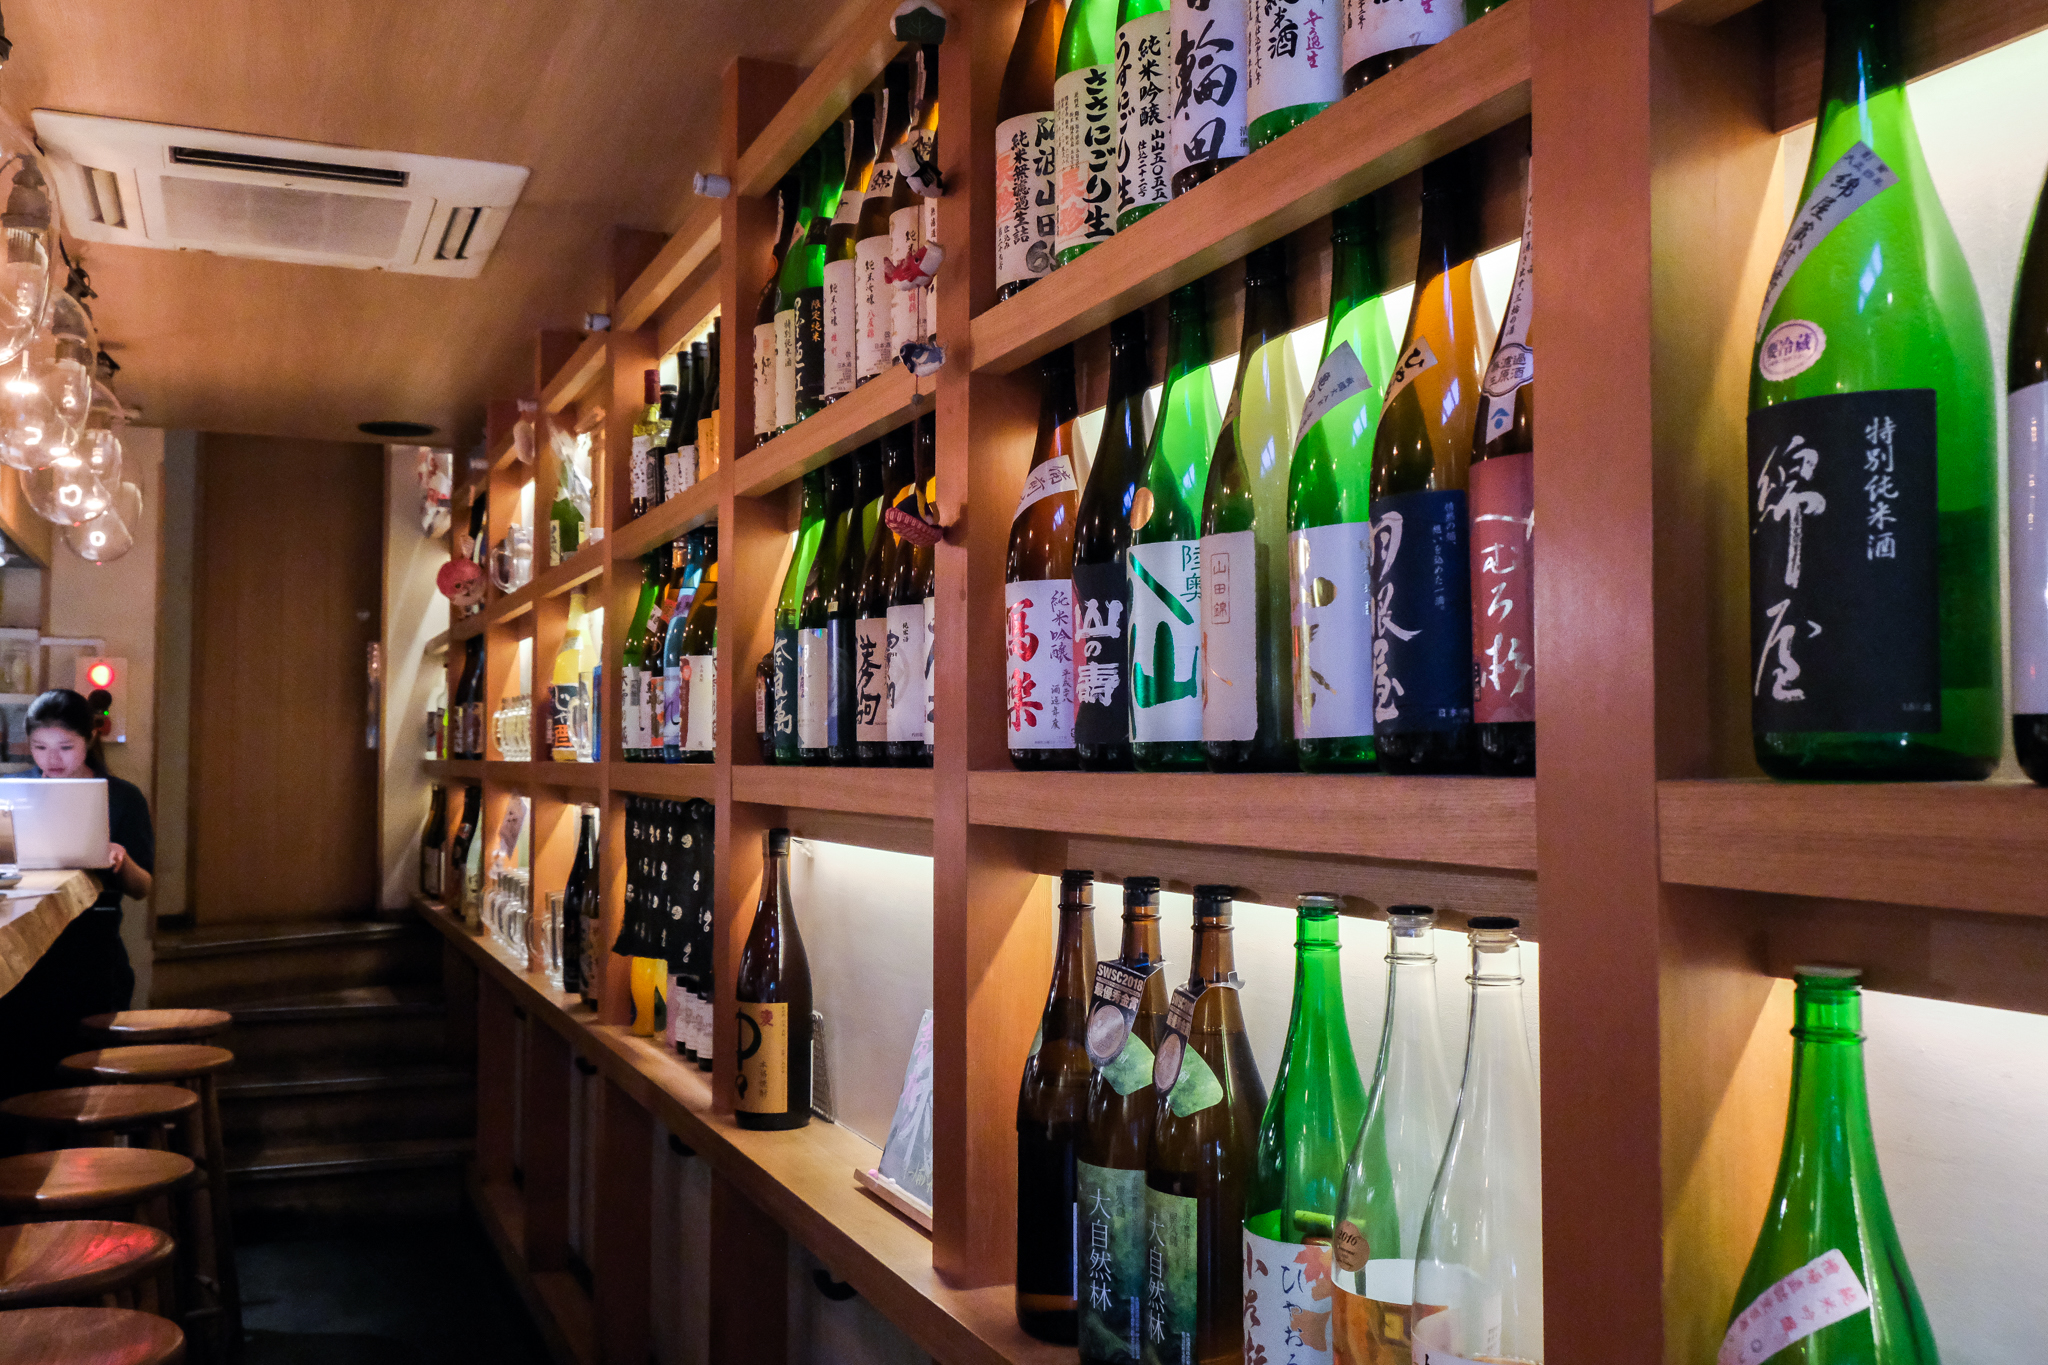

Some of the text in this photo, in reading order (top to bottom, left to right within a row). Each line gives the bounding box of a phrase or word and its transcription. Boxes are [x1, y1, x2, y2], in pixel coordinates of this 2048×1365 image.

[1138, 35, 1165, 127] 純米吟醸
[1083, 68, 1116, 239] ささにごり生
[1116, 32, 1136, 212] うすにごり生
[811, 299, 823, 342] 限定純米
[908, 289, 917, 313] 田錦
[1864, 416, 1899, 560] 特別純米酒
[1212, 559, 1228, 618] 山田錦
[1050, 590, 1073, 663] 純米吟醸
[1051, 684, 1061, 730] 酒造年度
[1097, 964, 1144, 992] SWSC2018
[1089, 1188, 1113, 1312] 大自然林
[1337, 1229, 1358, 1247] 2016
[1149, 1213, 1166, 1344] 大自然林
